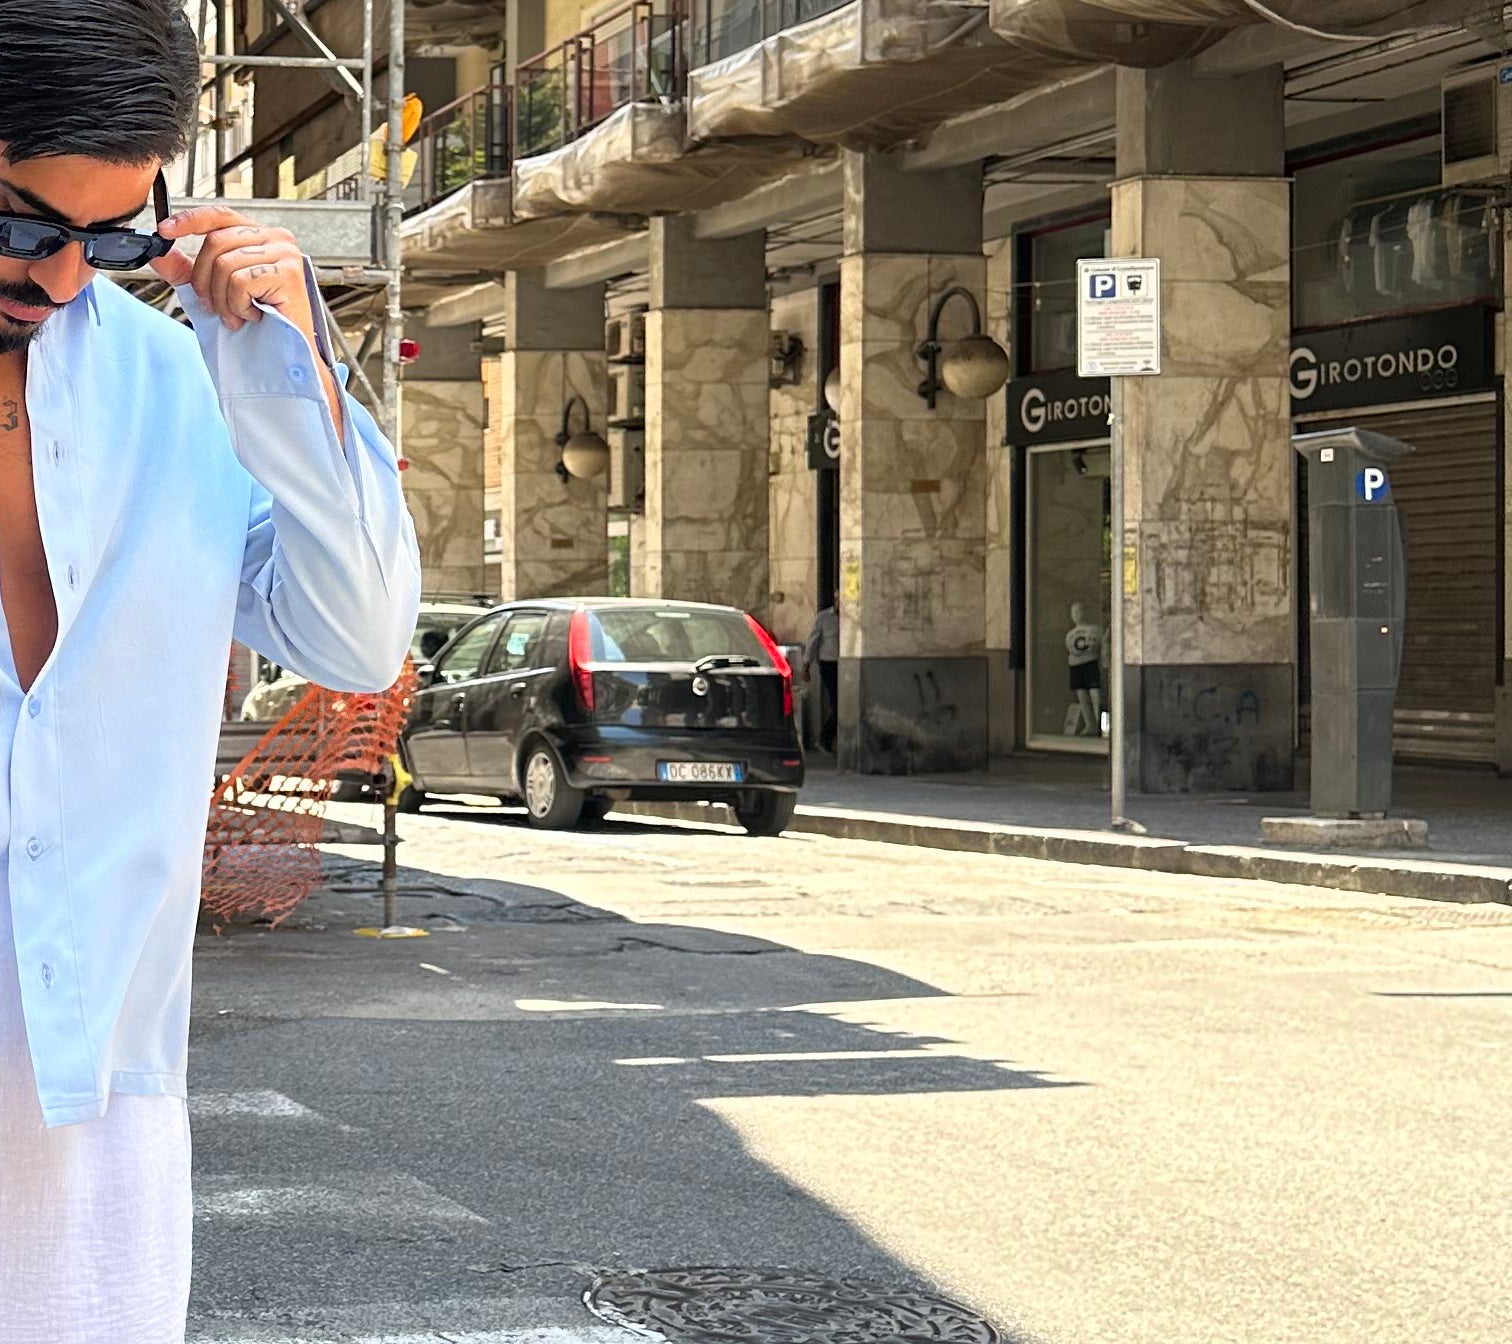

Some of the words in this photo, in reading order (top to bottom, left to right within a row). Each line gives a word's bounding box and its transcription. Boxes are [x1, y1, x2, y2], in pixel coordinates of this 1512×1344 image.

[1095, 275, 1113, 298] P
[1289, 344, 1458, 400] GIROTONDO
[1363, 467, 1385, 501] P
